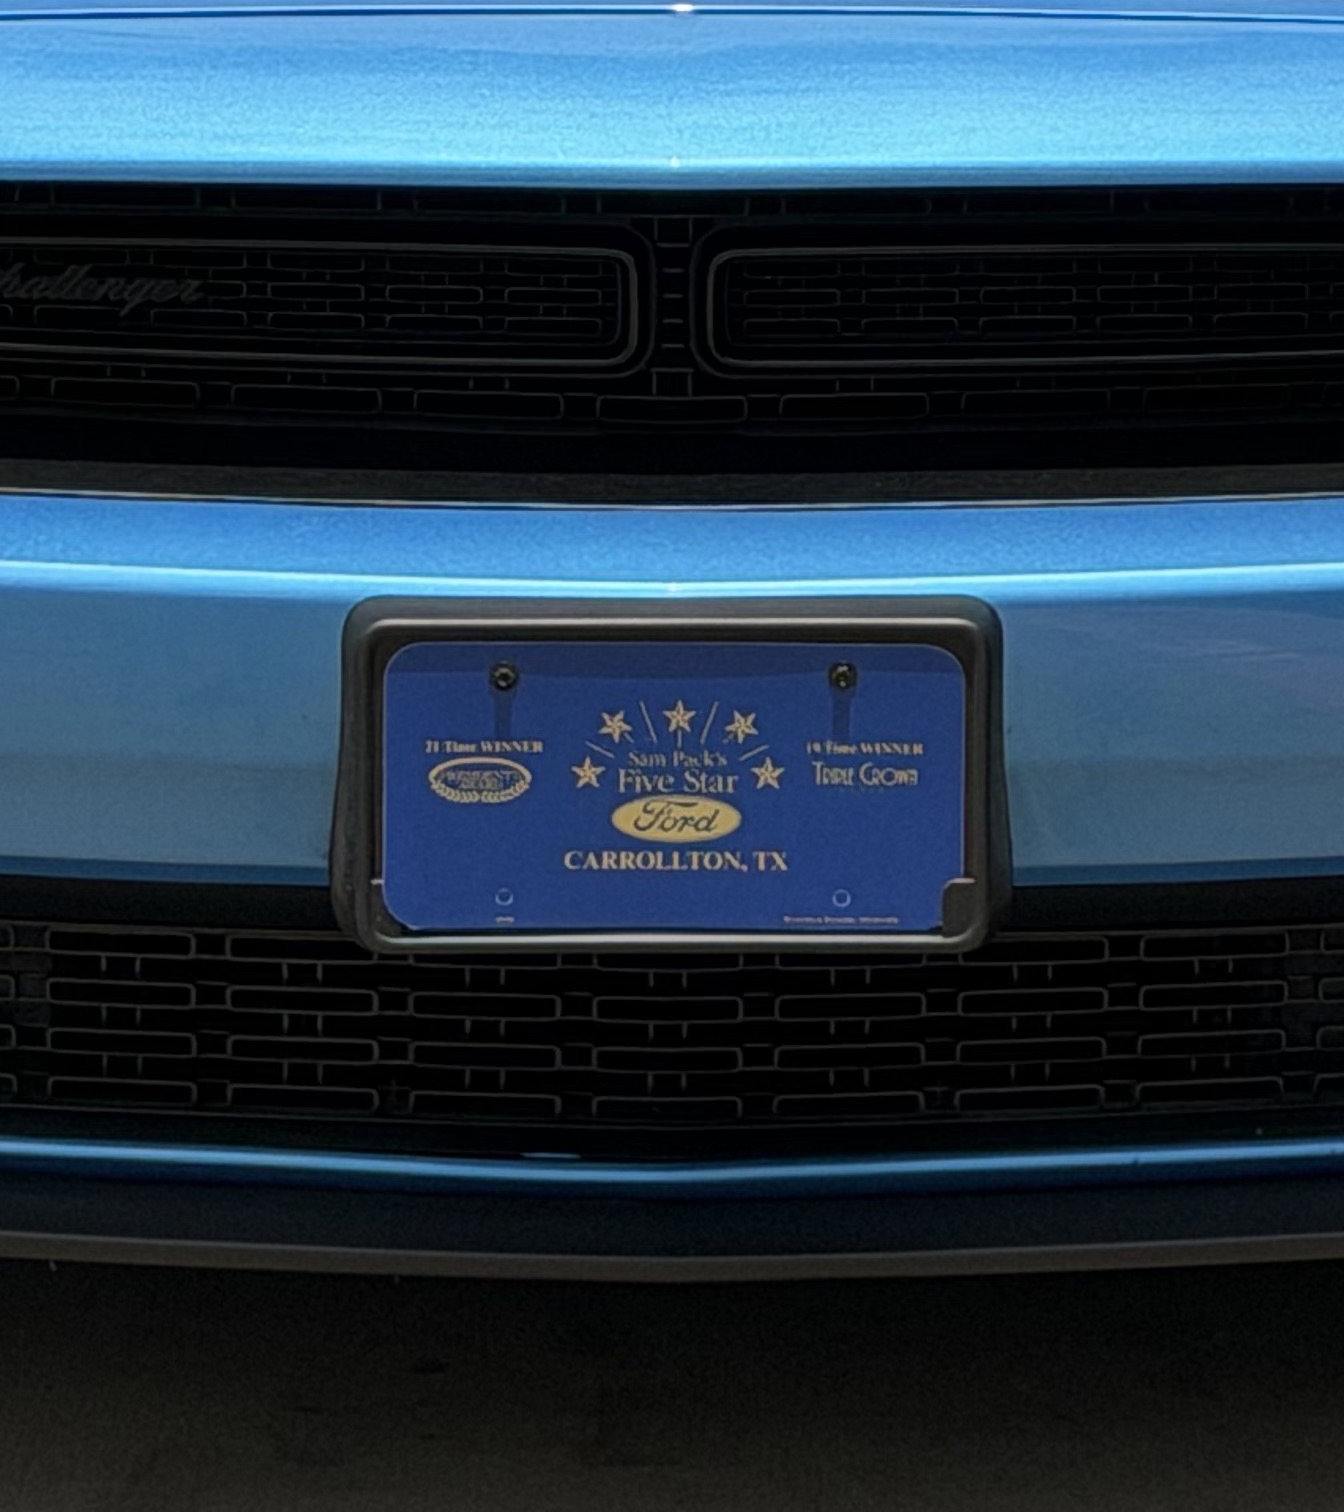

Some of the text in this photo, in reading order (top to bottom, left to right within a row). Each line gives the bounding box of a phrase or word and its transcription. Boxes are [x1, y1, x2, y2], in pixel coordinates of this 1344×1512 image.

[480, 740, 544, 753] WINNER
[860, 742, 924, 755] WINNER
[628, 750, 728, 768] Sam Pack's
[618, 768, 739, 793] Five Star
[633, 799, 720, 833] Ford
[563, 850, 789, 872] CARROLLTON, TX
